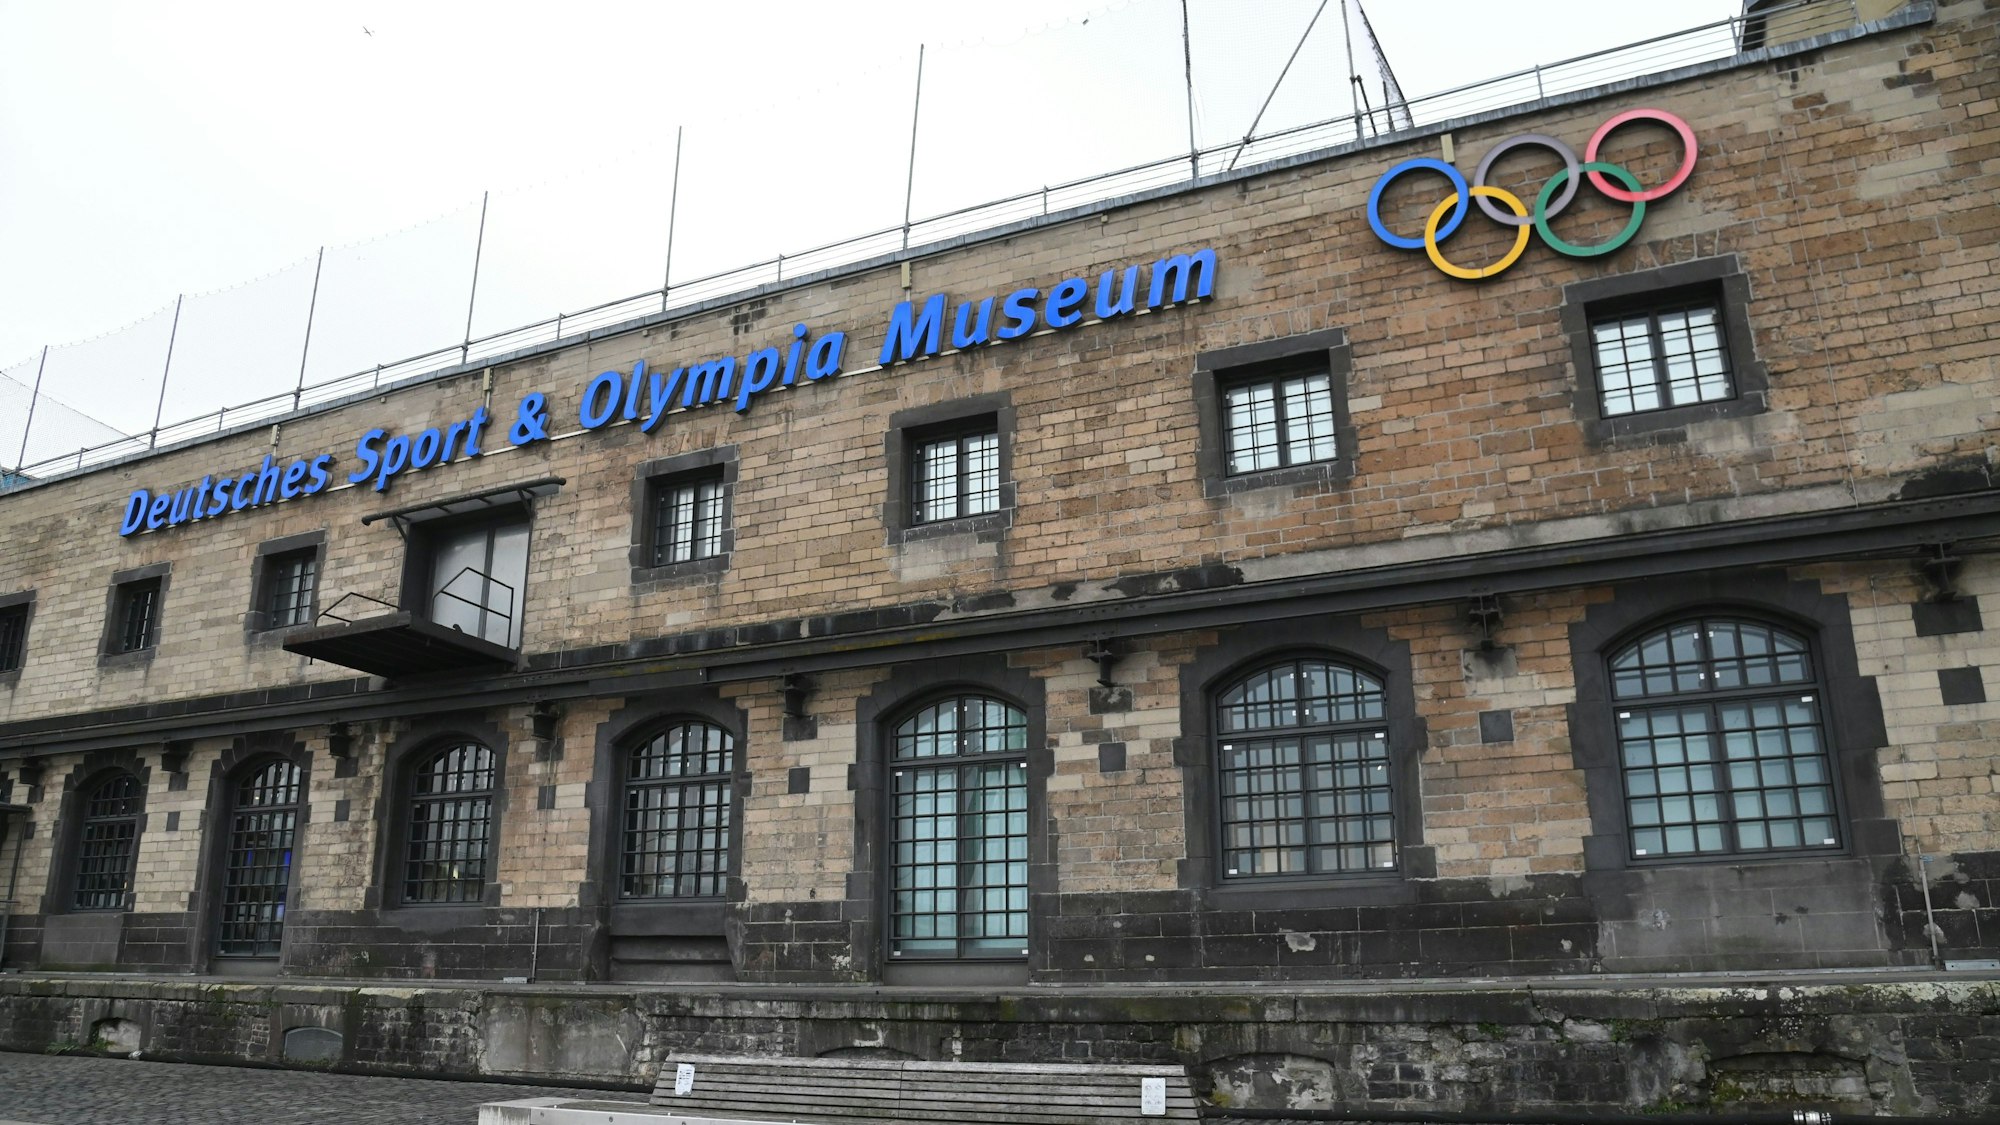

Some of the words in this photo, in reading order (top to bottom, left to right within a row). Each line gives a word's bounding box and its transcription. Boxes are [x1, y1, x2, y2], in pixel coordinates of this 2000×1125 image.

[120, 454, 332, 537] Deutsches
[348, 407, 489, 491] Sport
[508, 392, 548, 447] &
[579, 323, 846, 433] Olympia
[879, 249, 1218, 366] Museum
